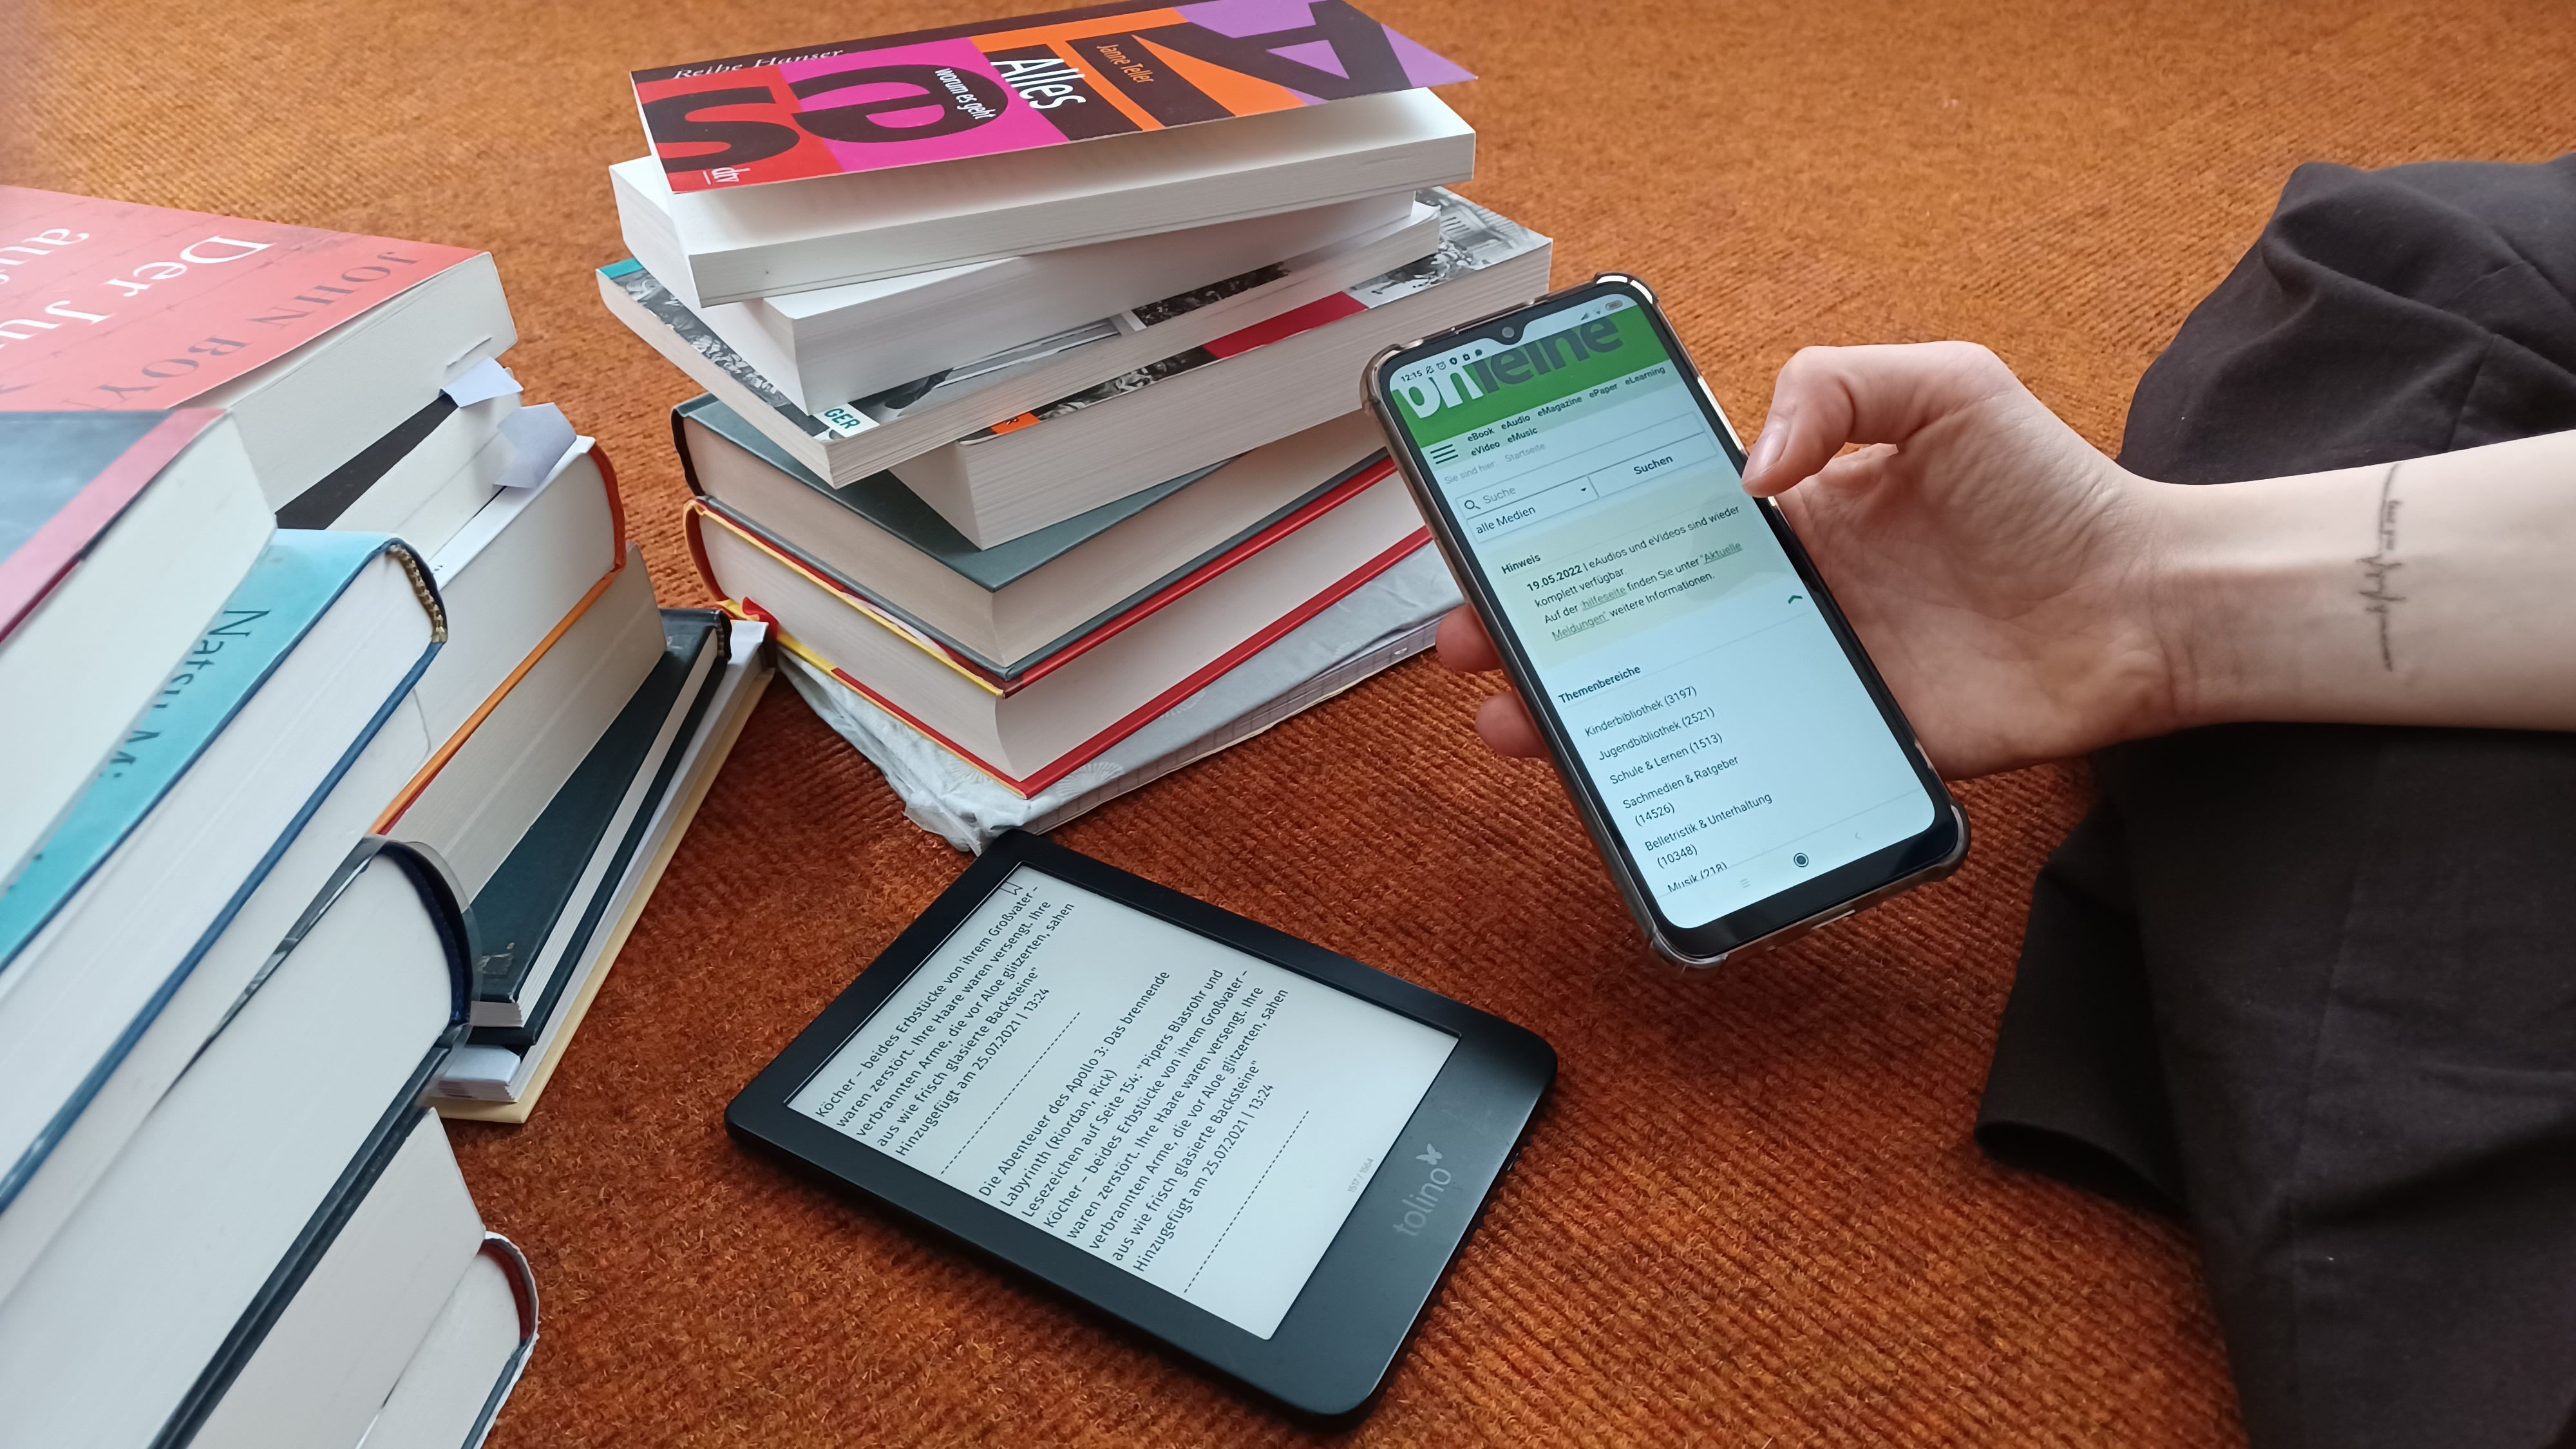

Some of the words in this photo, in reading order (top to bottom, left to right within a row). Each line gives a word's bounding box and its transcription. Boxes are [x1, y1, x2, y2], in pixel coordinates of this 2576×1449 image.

[672, 62, 743, 80] Reihe
[752, 50, 844, 68] Hanser
[934, 68, 969, 95] worum
[989, 58, 1086, 109] Alles
[1096, 44, 1131, 65] Janne
[1120, 62, 1154, 83] Teller
[956, 93, 978, 103] es
[956, 102, 997, 120] geht
[0, 228, 91, 285] au
[99, 234, 277, 298] Der
[245, 251, 424, 330] JOHN
[0, 300, 119, 350] Ju
[59, 334, 256, 412] BOY
[1401, 370, 1423, 383] 12:15
[1467, 427, 1495, 442] eBook
[1501, 414, 1531, 431] eAudio
[1537, 395, 1583, 417] eMagazine
[1589, 383, 1618, 398] ePaper
[1625, 366, 1666, 386] eLearning
[1470, 441, 1501, 456] eVideo
[1506, 427, 1538, 442] eMusic
[1633, 456, 1673, 475] Suchen
[1475, 522, 1495, 534] alle
[1495, 506, 1536, 526] Medien
[1482, 487, 1516, 504] Suche
[1501, 554, 1541, 574] Hinweis
[1526, 565, 1584, 592] 19.05.2022
[1588, 549, 1627, 568] eAudios
[1628, 540, 1647, 553] und
[1648, 526, 1687, 545] eVideos
[1687, 516, 1708, 531] sind
[1709, 506, 1739, 523] wieder
[1533, 585, 1578, 608] komplett
[1578, 567, 1627, 591] verfügbar.
[1544, 609, 1561, 624] Auf
[1562, 604, 1578, 616] der
[1626, 575, 1658, 591] finden
[1658, 568, 1674, 579] Sie
[1675, 558, 1700, 573] unter
[1608, 598, 1645, 617] weitere
[1644, 573, 1715, 603] Informationen.
[1557, 666, 1641, 703] Themenbereiche
[1584, 699, 1664, 737] Kinderbibliothek
[1663, 685, 1697, 706] (3197)
[1598, 721, 1681, 761] Jugendbibliothek
[1681, 706, 1715, 728] (2521)
[1609, 762, 1644, 784] Schule
[1653, 748, 1689, 766] Lernen
[1689, 732, 1723, 755] (1513)
[1622, 779, 1685, 809] Sachmedien
[1693, 756, 1738, 780] Ratgeber
[1634, 801, 1675, 827] (14526)
[1644, 822, 1699, 851] Belletristik
[1706, 793, 1772, 824] Unterhaltung
[1656, 843, 1698, 869] (10348)
[1666, 874, 1699, 895] Musik
[815, 1077, 856, 1117] Köcher
[860, 1034, 900, 1069] beides
[895, 985, 947, 1033] Erbstücke
[942, 965, 965, 983] von
[958, 937, 992, 965] ihrem
[987, 892, 1033, 936] Großvater
[835, 1093, 872, 1126] waren
[869, 1049, 915, 1092] zerstört.
[910, 1025, 936, 1046] Ihre
[931, 994, 965, 1024] Haare
[961, 963, 993, 992] waren
[989, 922, 1033, 962] versengt.
[1028, 902, 1051, 920] Ihre
[855, 1070, 922, 1135] verbrannten
[918, 1039, 952, 1070] Arme,
[948, 1019, 967, 1037] die
[963, 1001, 983, 1018] vor
[980, 979, 1005, 1002] Aloe
[1002, 933, 1050, 980] glitzerten,
[1045, 903, 1075, 931] sahen
[876, 1124, 900, 1146] aus
[896, 1104, 919, 1123] wie
[913, 1072, 948, 1103] frisch
[945, 1025, 990, 1072] glasierte
[984, 966, 1038, 1024] Backsteine"
[895, 1089, 961, 1156] Hinzugefügt
[956, 1071, 976, 1089] am
[971, 1019, 1021, 1070] 25.07.2021
[1023, 988, 1050, 1011] 13:24
[978, 1176, 1001, 1197] Die
[998, 1114, 1050, 1175] Abenteuer
[1048, 1093, 1070, 1113] des
[1065, 1057, 1099, 1093] Apollo
[1093, 1046, 1109, 1057] 3:
[1103, 1025, 1126, 1045] Das
[1119, 972, 1170, 1024] brennende
[1021, 1146, 1084, 1217] Lesezeichen
[1080, 1122, 1101, 1145] auf
[1095, 1095, 1124, 1124] Seite
[1119, 1073, 1143, 1094] 154:
[1136, 1033, 1173, 1069] "Pipers
[1167, 989, 1207, 1033] Blasrohr
[1203, 969, 1223, 990] und
[1043, 1184, 1082, 1228] Köcher
[1083, 1135, 1122, 1173] beides
[1116, 1080, 1165, 1133] Erbstücke
[1160, 1059, 1181, 1078] von
[1173, 1027, 1206, 1057] ihrem
[1200, 976, 1244, 1025] Großvater
[999, 1151, 1052, 1207] Labyrinth
[1045, 1100, 1096, 1150] (Riordan,
[1088, 1068, 1117, 1097] Rick)
[1066, 1200, 1101, 1238] waren
[1097, 1151, 1141, 1200] zerstört.
[1133, 1124, 1159, 1148] Ihre
[1152, 1090, 1185, 1123] Haare
[1180, 1056, 1211, 1088] waren
[1206, 1010, 1247, 1054] versengt.
[1240, 987, 1264, 1008] Ihre
[1088, 1175, 1150, 1249] verbrannten
[1145, 1141, 1179, 1175] Arme,
[1172, 1119, 1191, 1138] die
[1186, 1098, 1206, 1117] vor
[1201, 1074, 1226, 1099] Aloe
[1222, 1022, 1267, 1074] glitzerten,
[1260, 989, 1288, 1020] sahen
[1112, 1236, 1134, 1261] aus
[1130, 1213, 1152, 1235] wie
[1145, 1177, 1178, 1211] frisch
[1174, 1125, 1216, 1177] glasierte
[1209, 1059, 1259, 1124] Backsteine"
[1132, 1197, 1194, 1272] Hinzugefügt
[1188, 1177, 1208, 1197] am
[1201, 1119, 1249, 1175] 25.07.2021
[1248, 1084, 1274, 1110] 13:24
[1347, 1177, 1360, 1193] 1517
[1359, 1157, 1374, 1173] 1564
[1392, 1167, 1452, 1237] tolino
